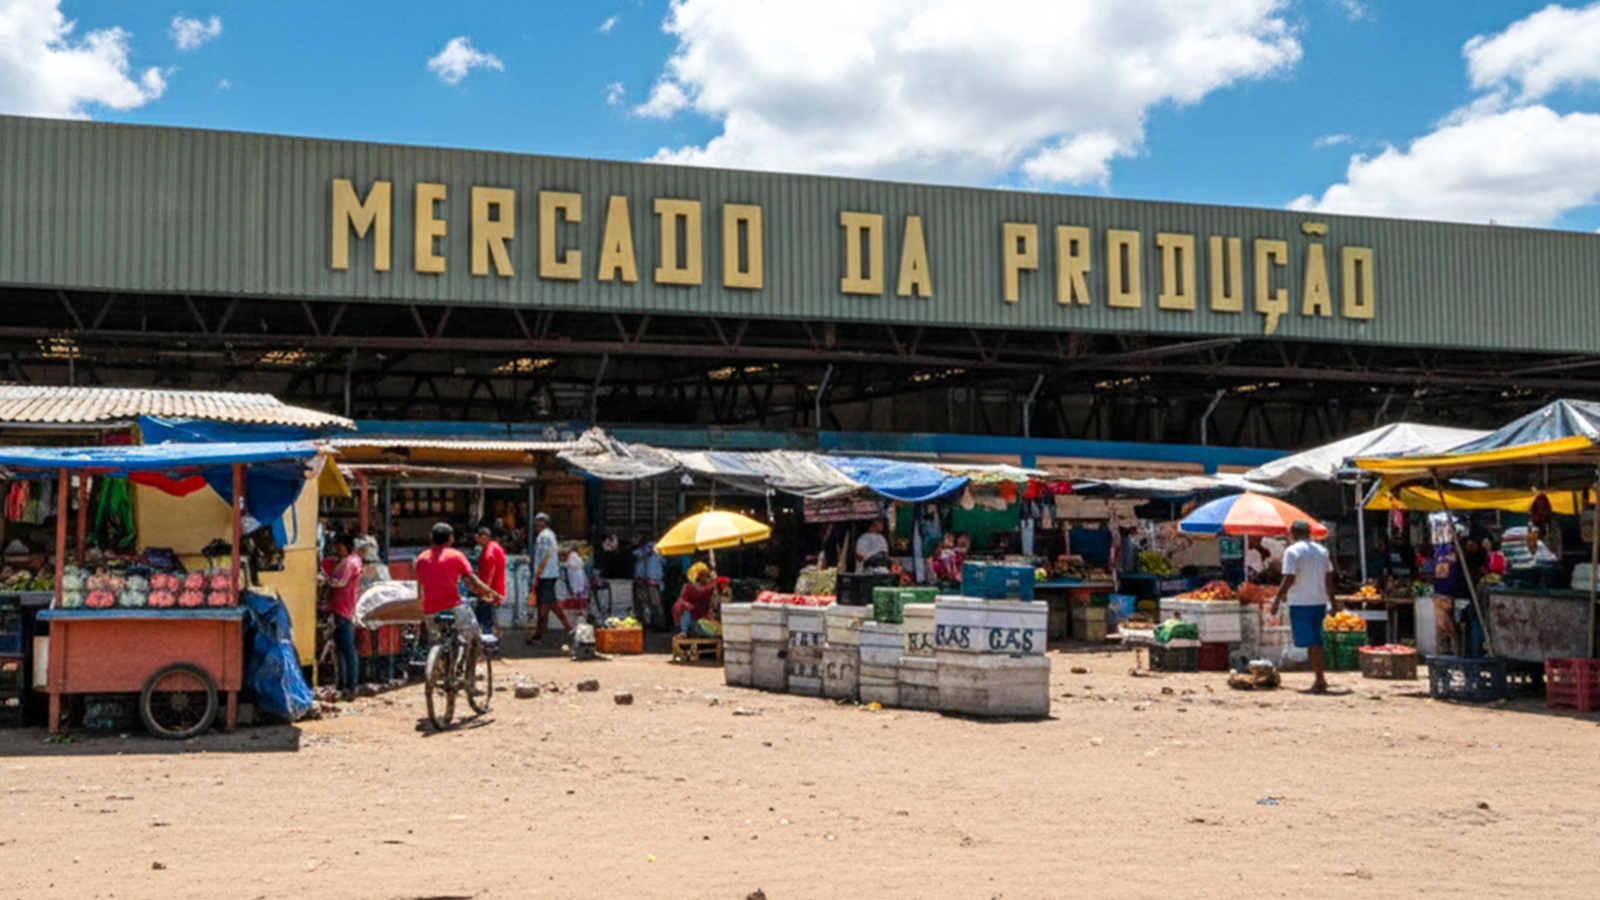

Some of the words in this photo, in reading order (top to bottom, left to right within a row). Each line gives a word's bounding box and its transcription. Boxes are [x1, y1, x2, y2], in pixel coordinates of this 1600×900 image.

[332, 179, 764, 289] MERCADO
[840, 211, 932, 297] DA
[1003, 222, 1375, 335] PRODUÇÃO
